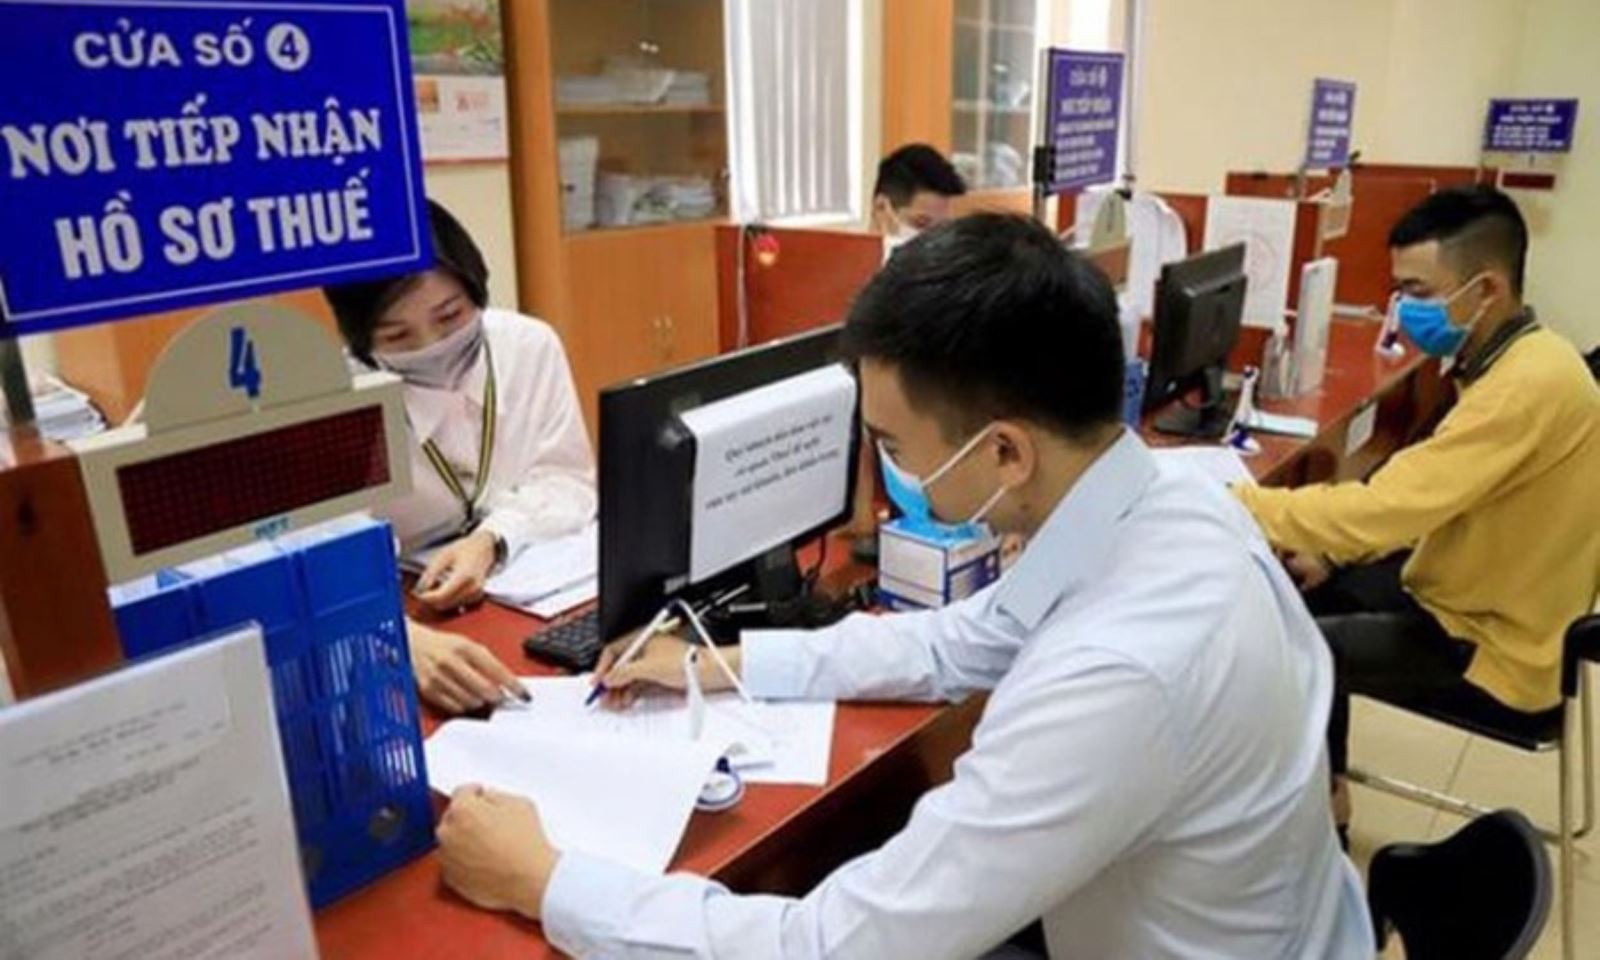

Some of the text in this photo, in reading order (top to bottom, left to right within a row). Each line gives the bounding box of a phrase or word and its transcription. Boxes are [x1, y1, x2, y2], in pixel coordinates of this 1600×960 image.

[74, 18, 182, 68] CỬA
[194, 18, 254, 67] SỐ
[1, 93, 382, 178] NƠI TIẾP NHẬN
[54, 168, 373, 279] HỒ SƠ THUẾ
[229, 327, 261, 399] 4
